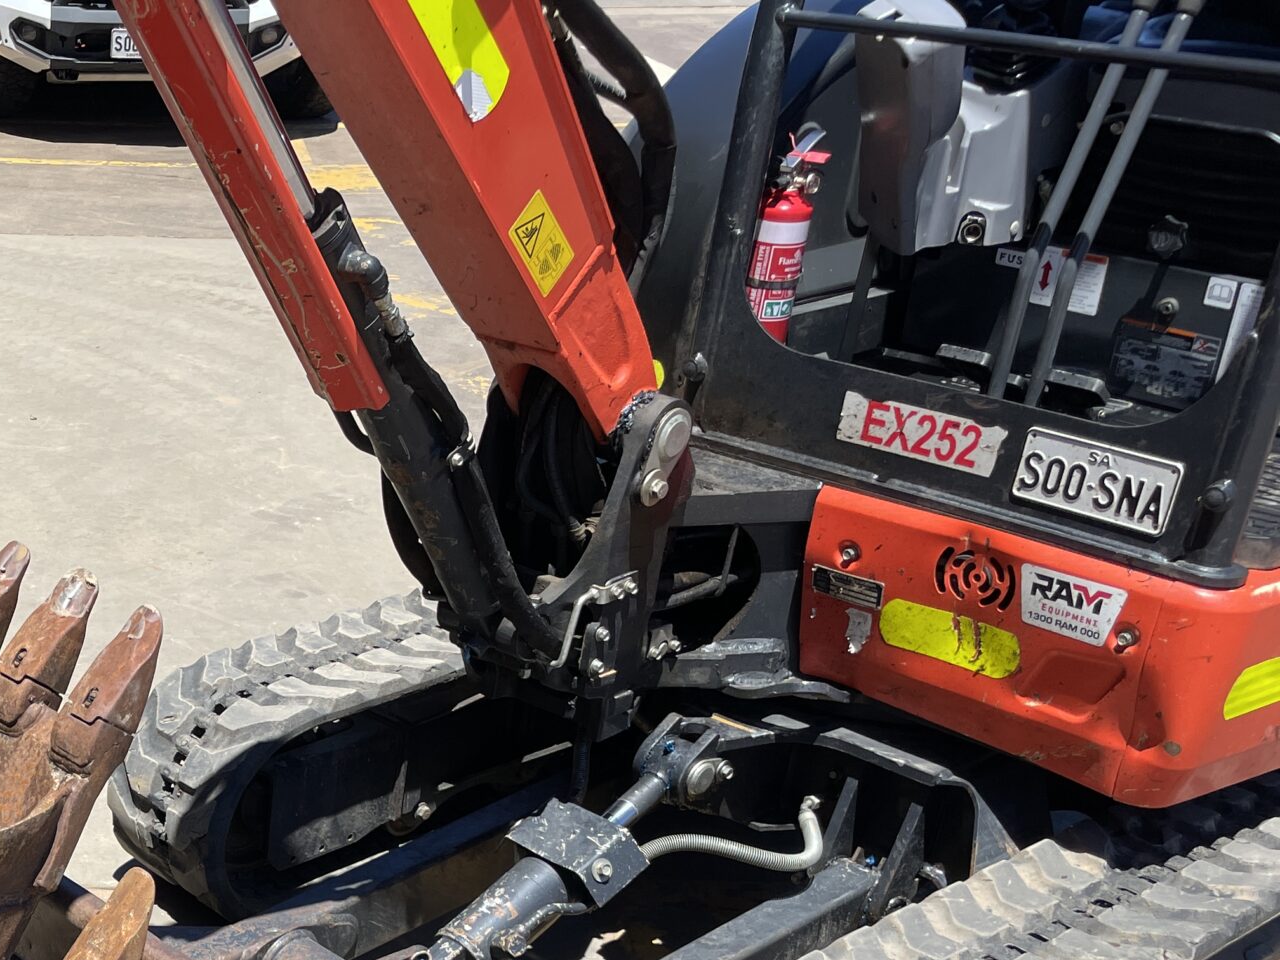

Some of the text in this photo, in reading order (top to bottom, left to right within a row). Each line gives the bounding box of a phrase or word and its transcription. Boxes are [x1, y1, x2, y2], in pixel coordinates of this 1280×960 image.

[999, 252, 1023, 265] FUS
[860, 399, 983, 468] EX252
[1088, 451, 1111, 467] SA
[1030, 572, 1113, 615] RAM
[1027, 610, 1101, 640] 1300 RAM 000
[1040, 603, 1098, 627] EQUIPMENT
